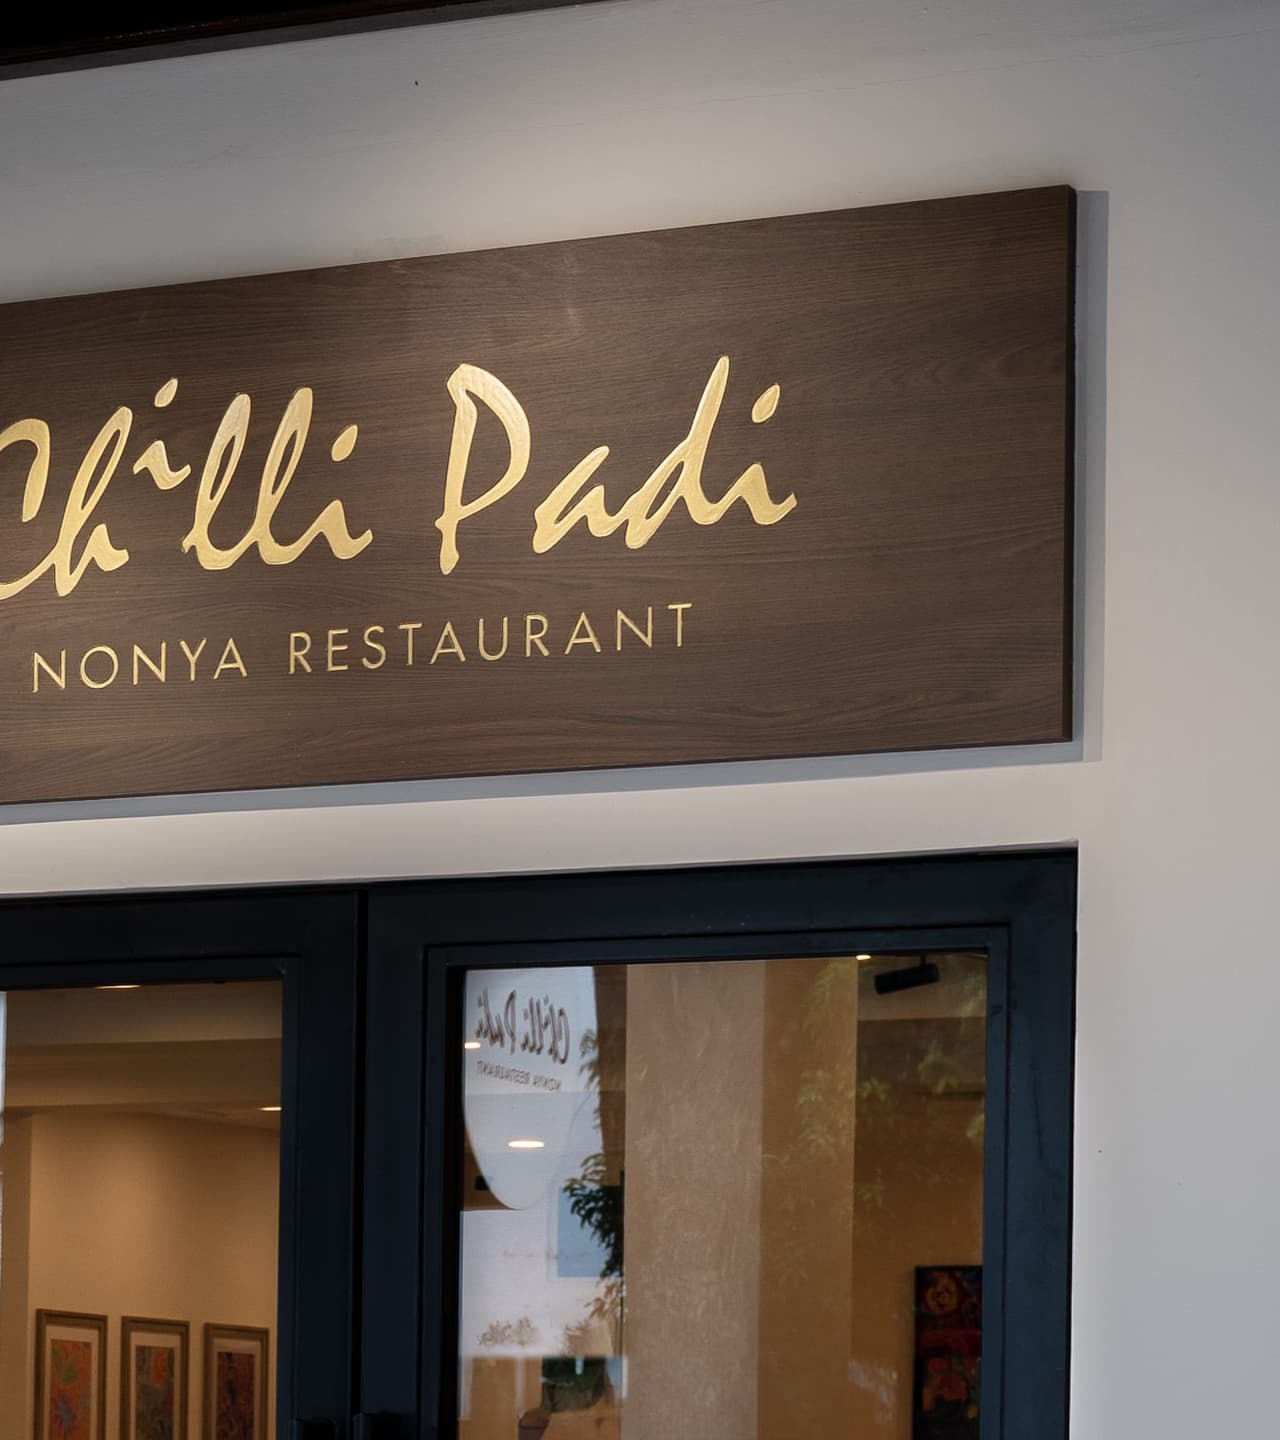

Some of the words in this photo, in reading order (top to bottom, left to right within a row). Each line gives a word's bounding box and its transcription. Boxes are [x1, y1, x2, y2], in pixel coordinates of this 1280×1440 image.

[433, 354, 798, 576] Padi
[31, 636, 249, 694] NONYA
[288, 602, 695, 675] RESTAURANT
